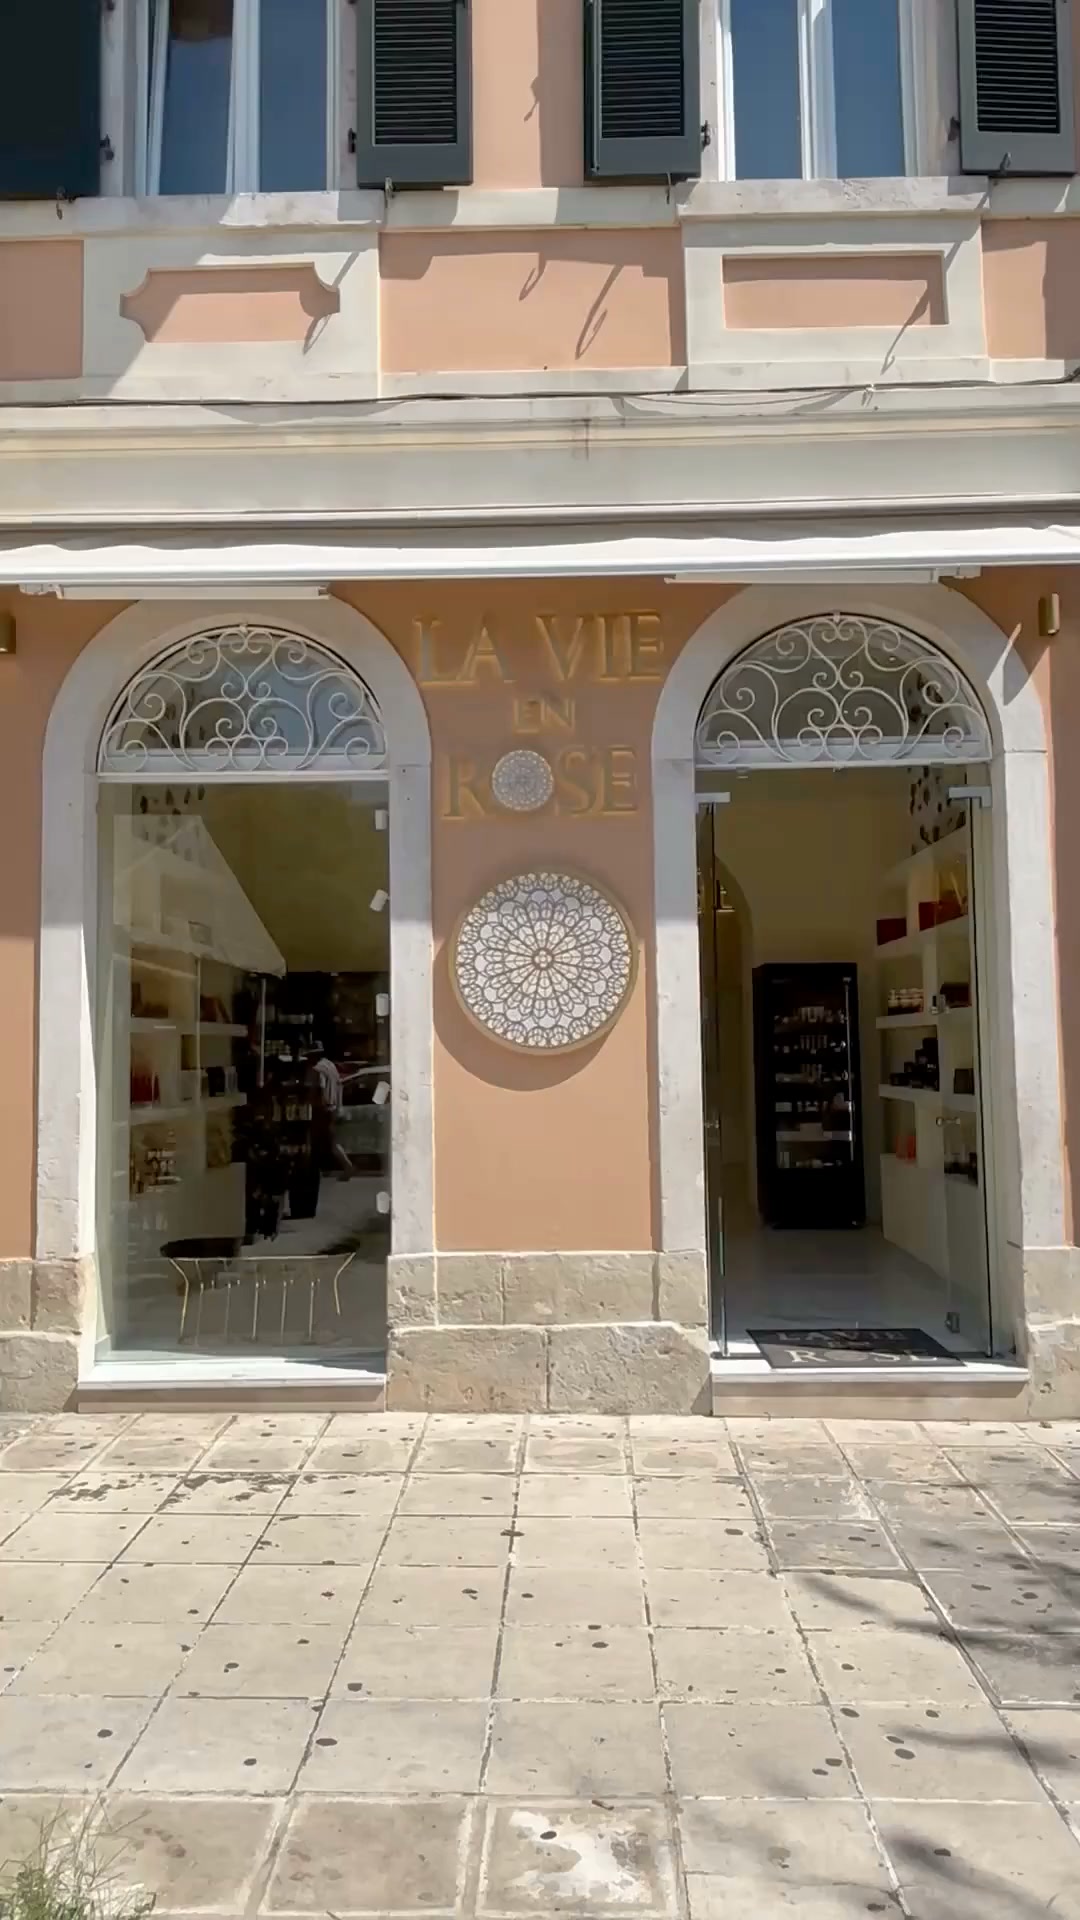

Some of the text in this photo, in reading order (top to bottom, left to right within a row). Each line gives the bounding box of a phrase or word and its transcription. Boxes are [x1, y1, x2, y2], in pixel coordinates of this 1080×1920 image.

[412, 609, 664, 687] LA VIE
[513, 691, 576, 735] EN
